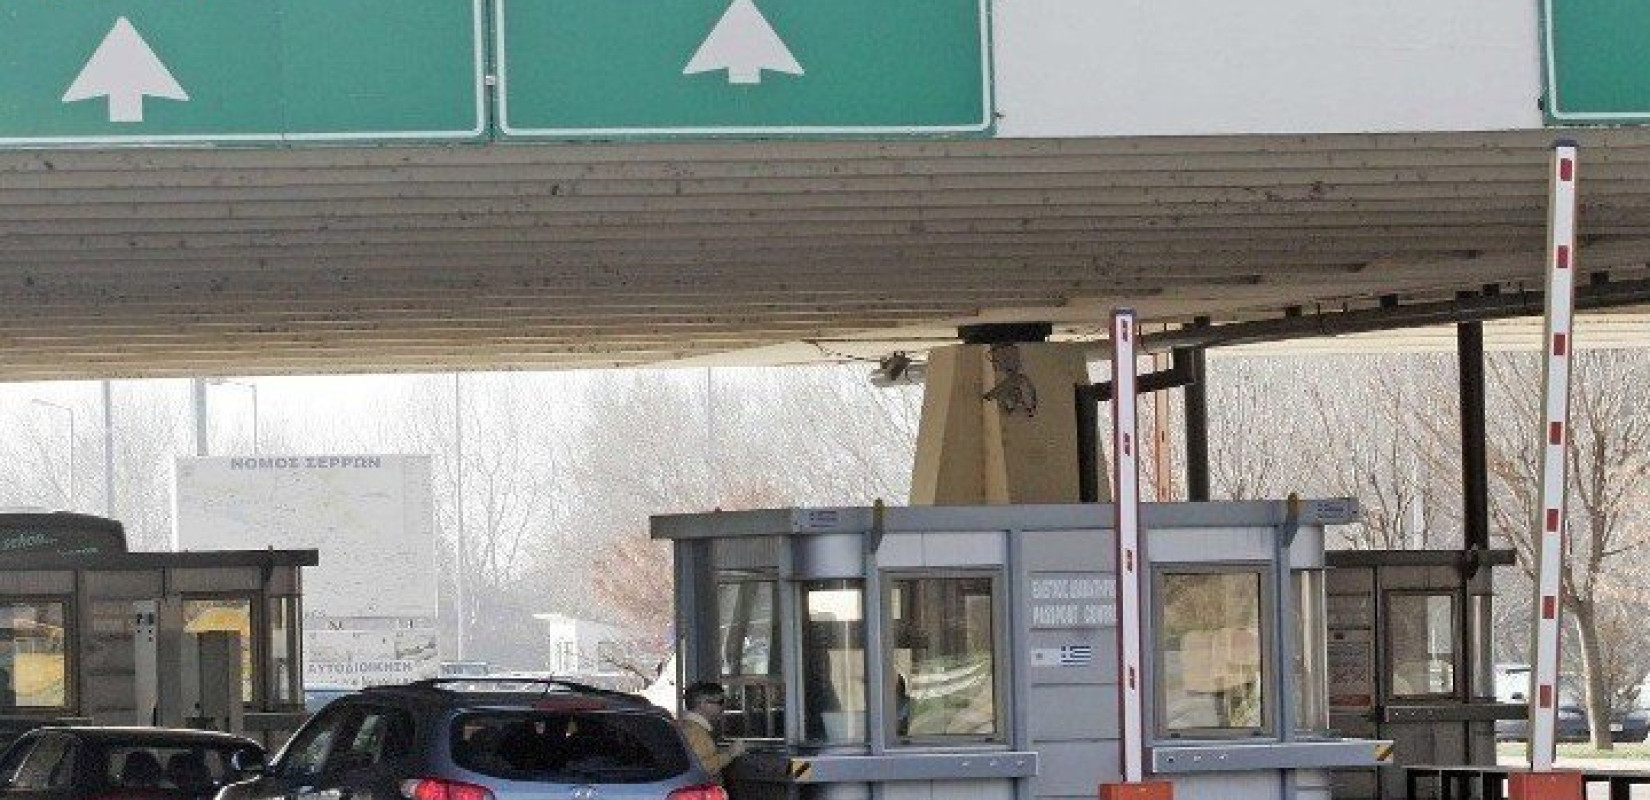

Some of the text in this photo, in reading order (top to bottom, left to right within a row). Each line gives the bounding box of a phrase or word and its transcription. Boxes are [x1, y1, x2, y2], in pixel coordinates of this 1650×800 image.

[230, 455, 382, 470] ΝΟΜΟΣ ΣΕΡΡΩΝ
[1032, 604, 1078, 625] PASSPORT
